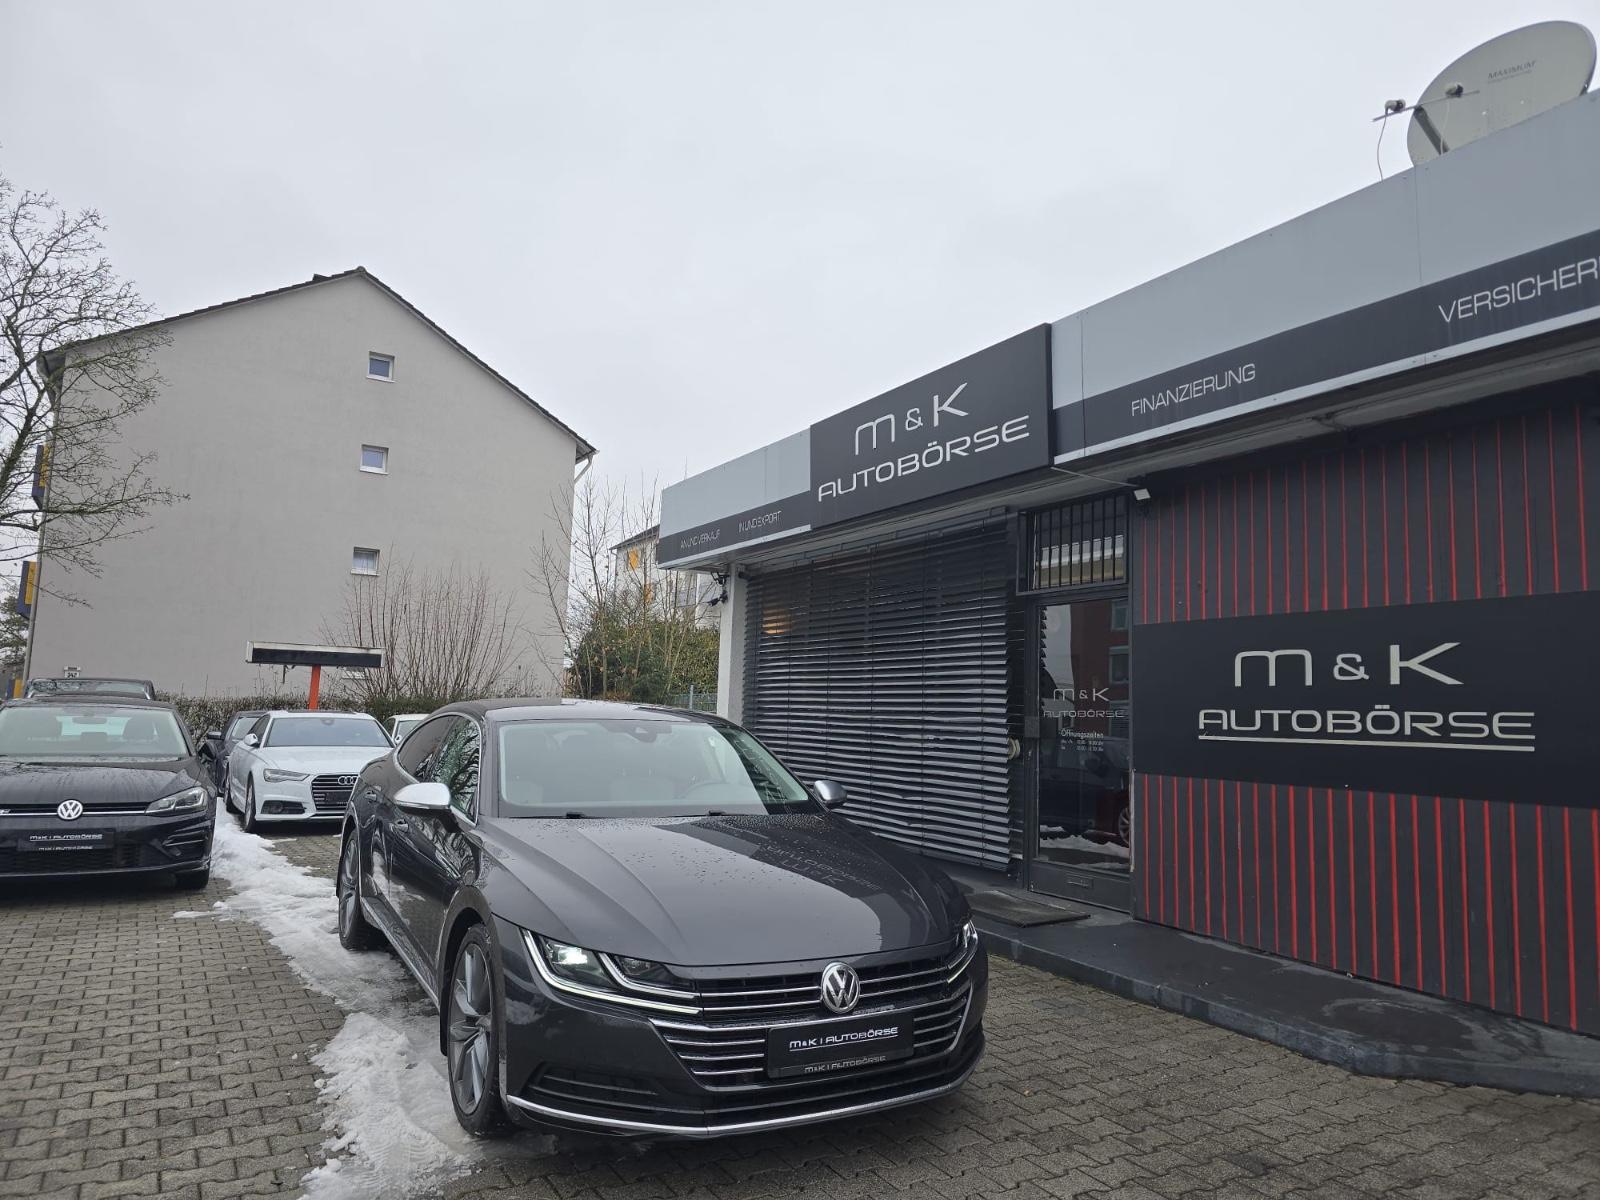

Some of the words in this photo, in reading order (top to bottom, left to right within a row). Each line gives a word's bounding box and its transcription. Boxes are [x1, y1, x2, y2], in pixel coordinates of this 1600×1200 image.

[1488, 60, 1537, 79] MAXIMUM
[1438, 258, 1600, 324] VERSICHER
[1131, 363, 1256, 417] FINANZIERUNG
[854, 413, 896, 456] M
[905, 407, 924, 431] &
[933, 382, 969, 428] K
[818, 415, 1030, 503] AUTOBÖRSE
[1234, 648, 1313, 688] M
[1333, 653, 1370, 681] &
[1390, 642, 1465, 685] K
[1053, 688, 1075, 702] M
[1079, 689, 1088, 699] &
[1092, 687, 1110, 702] K
[1043, 708, 1128, 718] AUTOBÖRSE
[1198, 704, 1536, 740] AUTOBÖRSE
[1060, 727, 1104, 740] Öffnungszeiten
[825, 1026, 899, 1044] AUTOBÖRSE
[831, 1055, 887, 1070] AUTOBÖRSE
